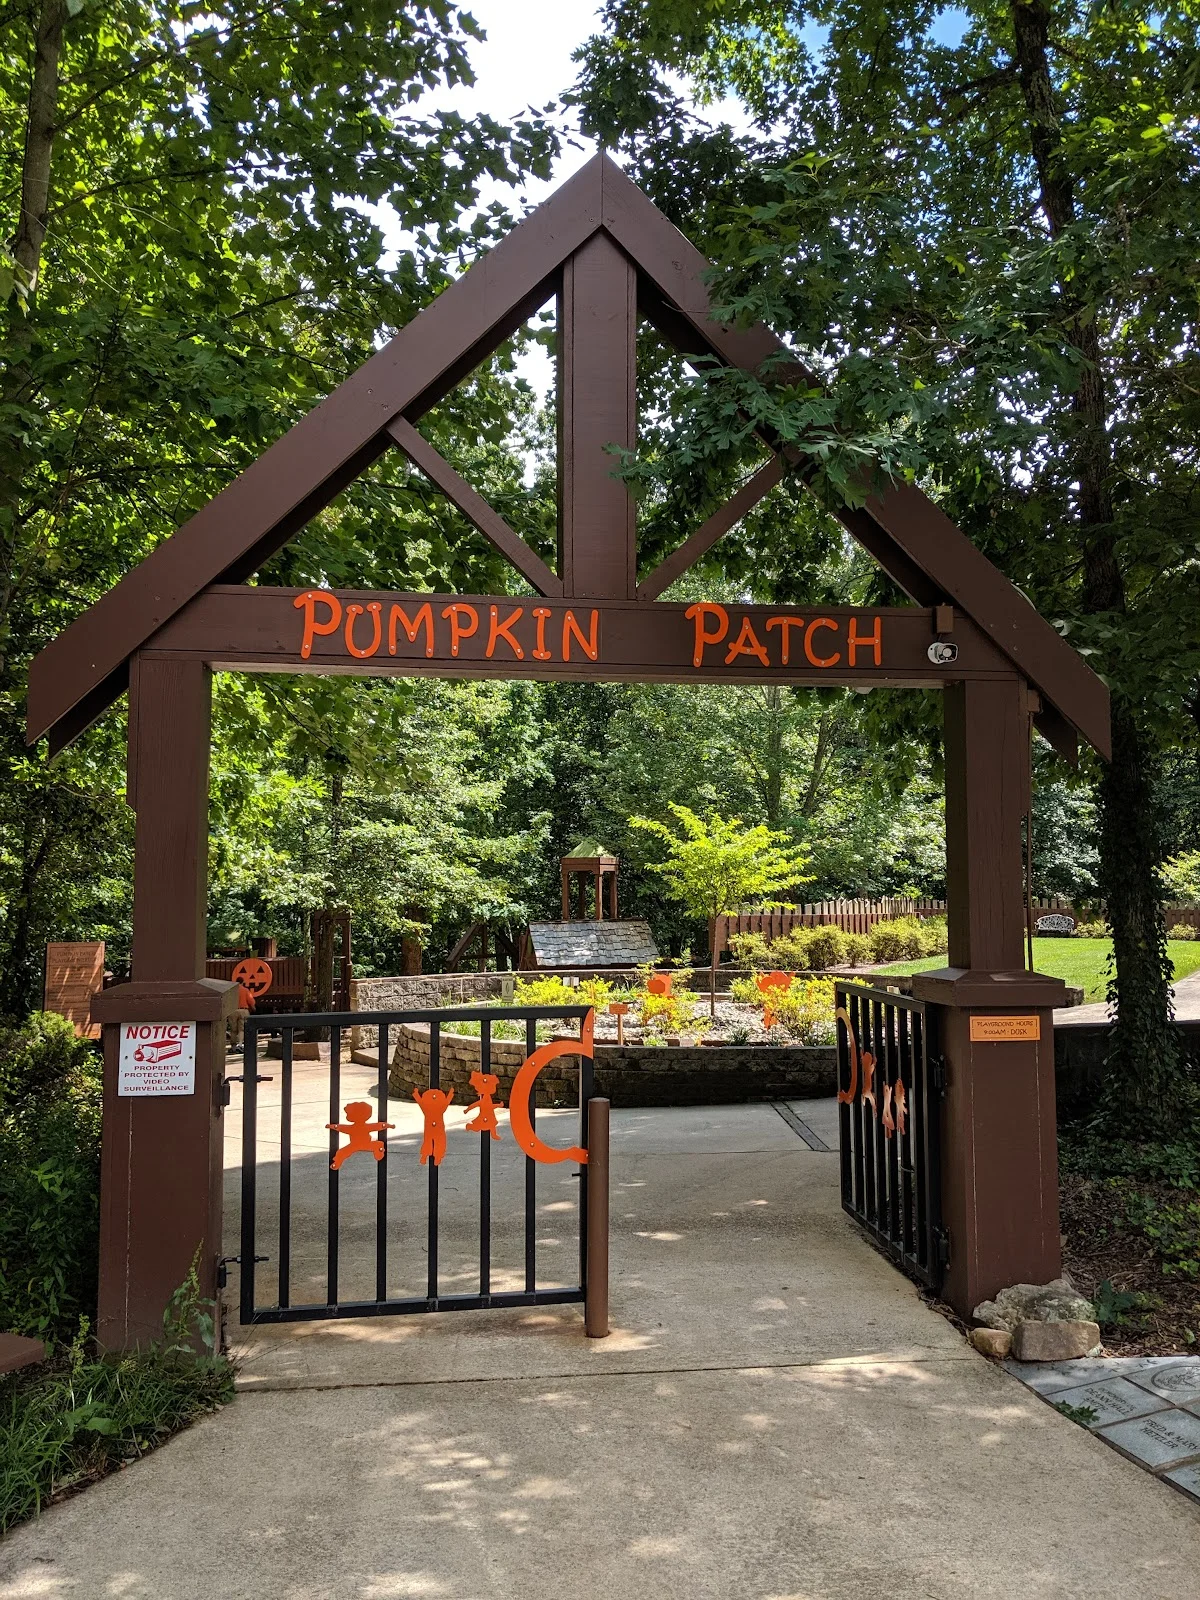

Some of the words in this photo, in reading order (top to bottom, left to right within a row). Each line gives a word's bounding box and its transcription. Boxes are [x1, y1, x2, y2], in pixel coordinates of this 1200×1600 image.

[293, 590, 599, 662] PUMPKIN
[684, 601, 882, 668] PATCH
[126, 1025, 190, 1039] NOTICE
[1142, 1419, 1167, 1432] FRED
[1172, 1435, 1198, 1450] MARY
